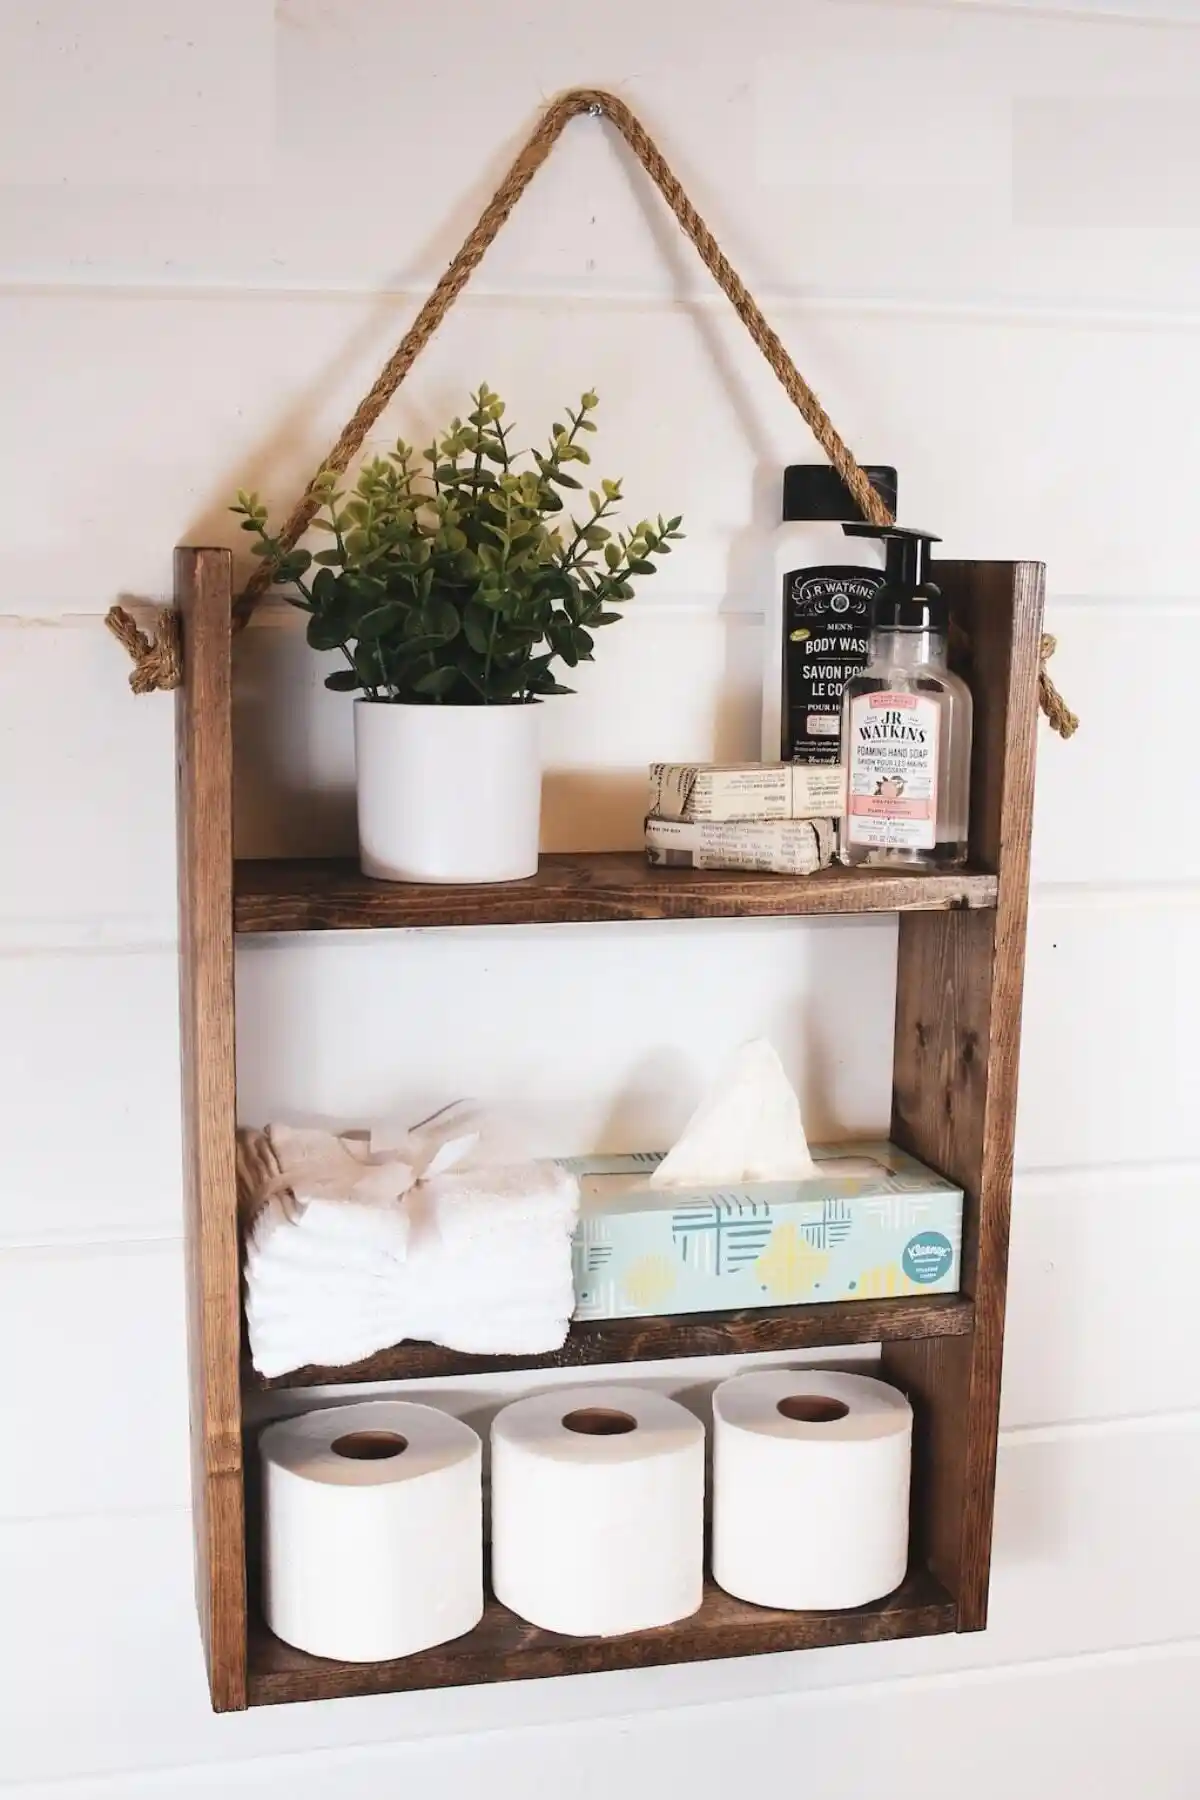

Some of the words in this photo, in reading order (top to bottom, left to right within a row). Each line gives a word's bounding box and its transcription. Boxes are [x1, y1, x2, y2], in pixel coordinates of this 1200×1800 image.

[825, 582, 875, 600] WATKINS
[826, 623, 853, 631] MEN'S
[805, 638, 836, 654] BODY
[803, 665, 841, 680] SAVON
[812, 682, 825, 696] LE
[881, 711, 902, 724] JR
[859, 724, 927, 743] WATKINS
[857, 745, 886, 758] FOAMING
[888, 747, 907, 759] HAND
[909, 747, 929, 760] SOAP
